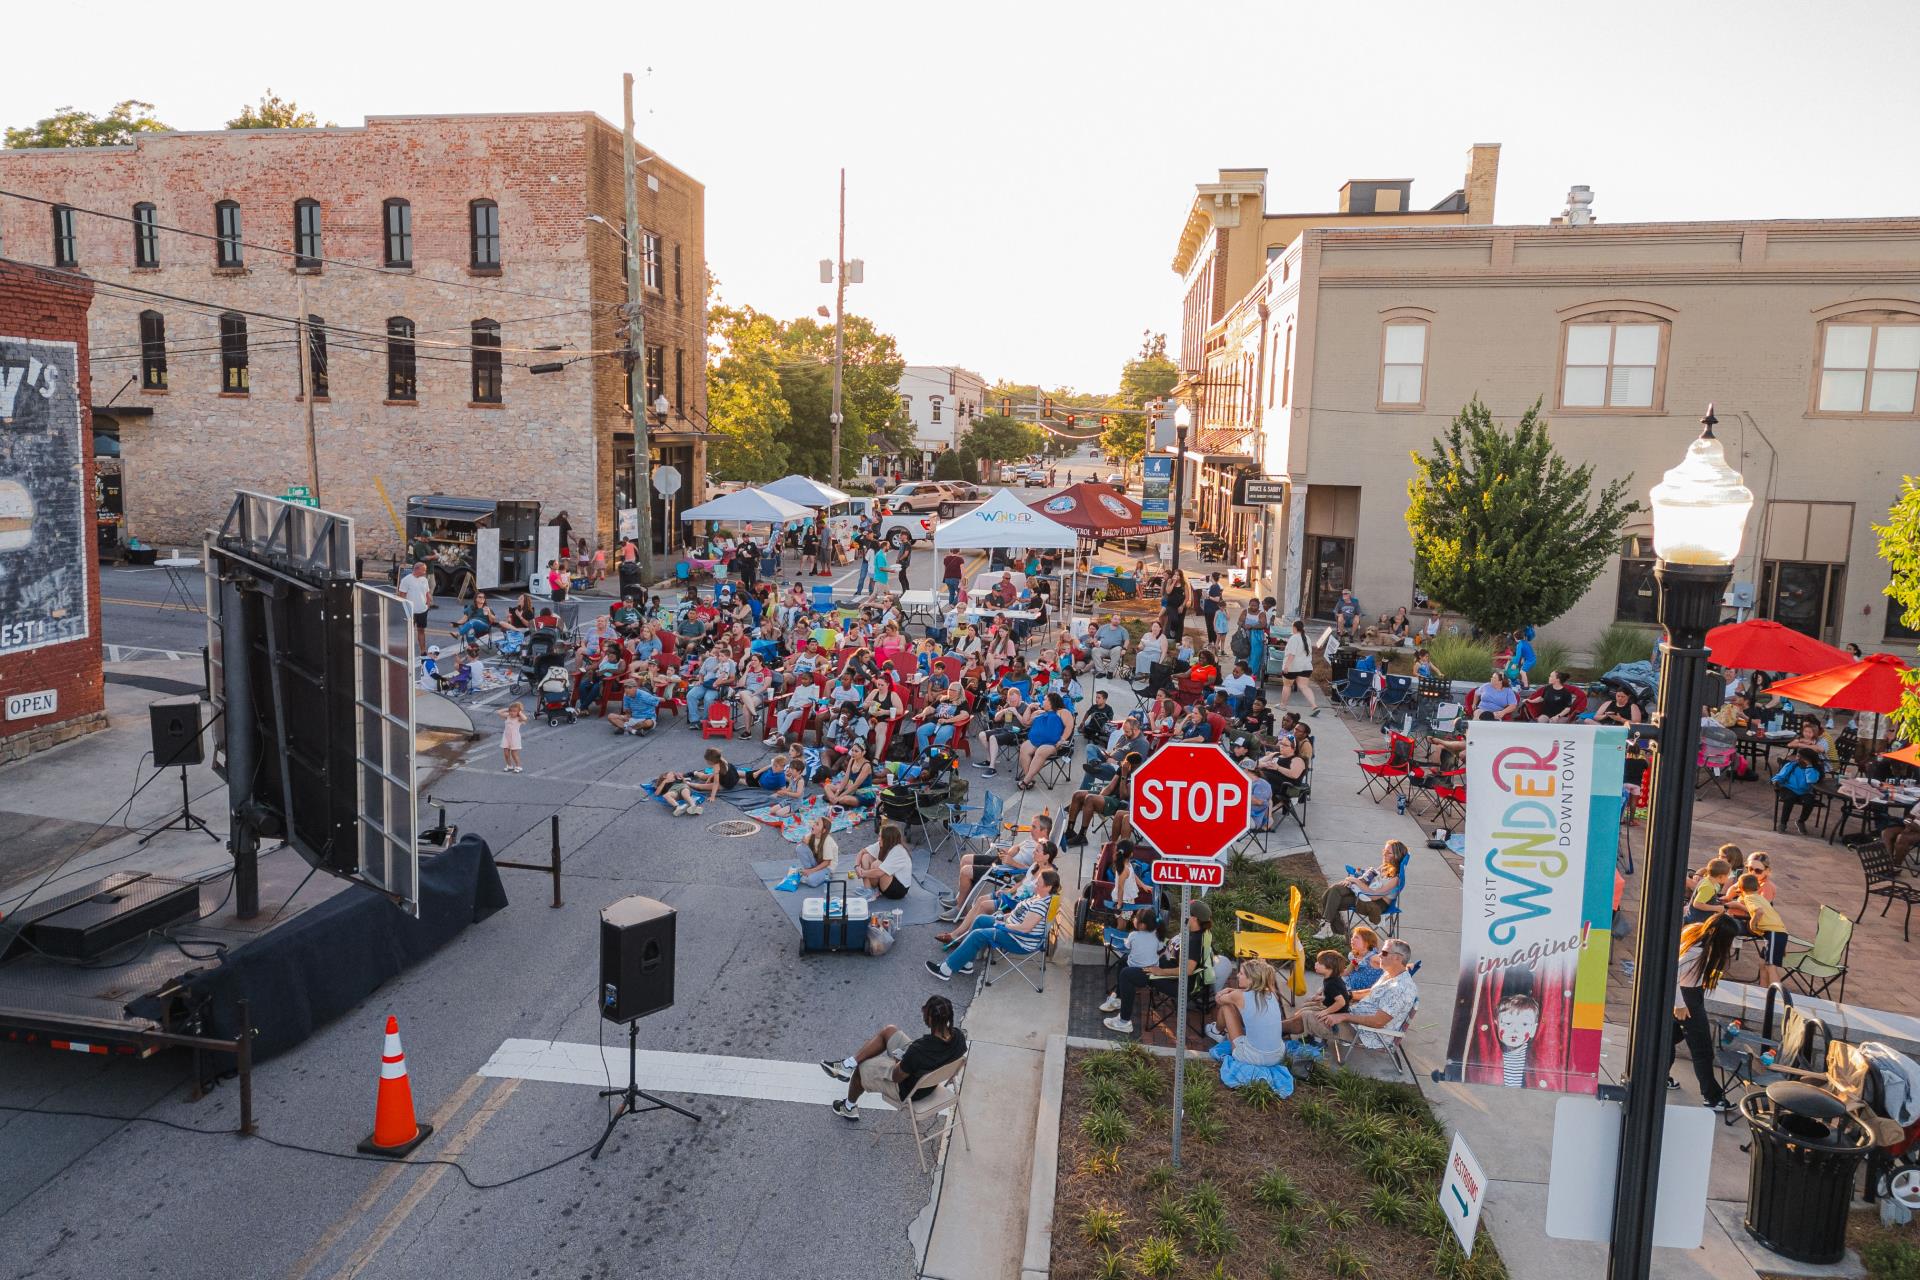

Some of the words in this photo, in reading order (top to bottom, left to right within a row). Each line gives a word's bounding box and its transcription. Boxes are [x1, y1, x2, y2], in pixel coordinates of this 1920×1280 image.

[975, 510, 1035, 523] WINDER
[10, 694, 53, 715] OPEN
[1139, 778, 1242, 823] STOP
[1559, 739, 1576, 847] DOWNTOWN
[1484, 740, 1569, 946] WINDER
[1159, 866, 1183, 880] ALL
[1188, 867, 1216, 882] WAY
[1483, 877, 1497, 918] VISIT
[1477, 920, 1592, 976] imagine!
